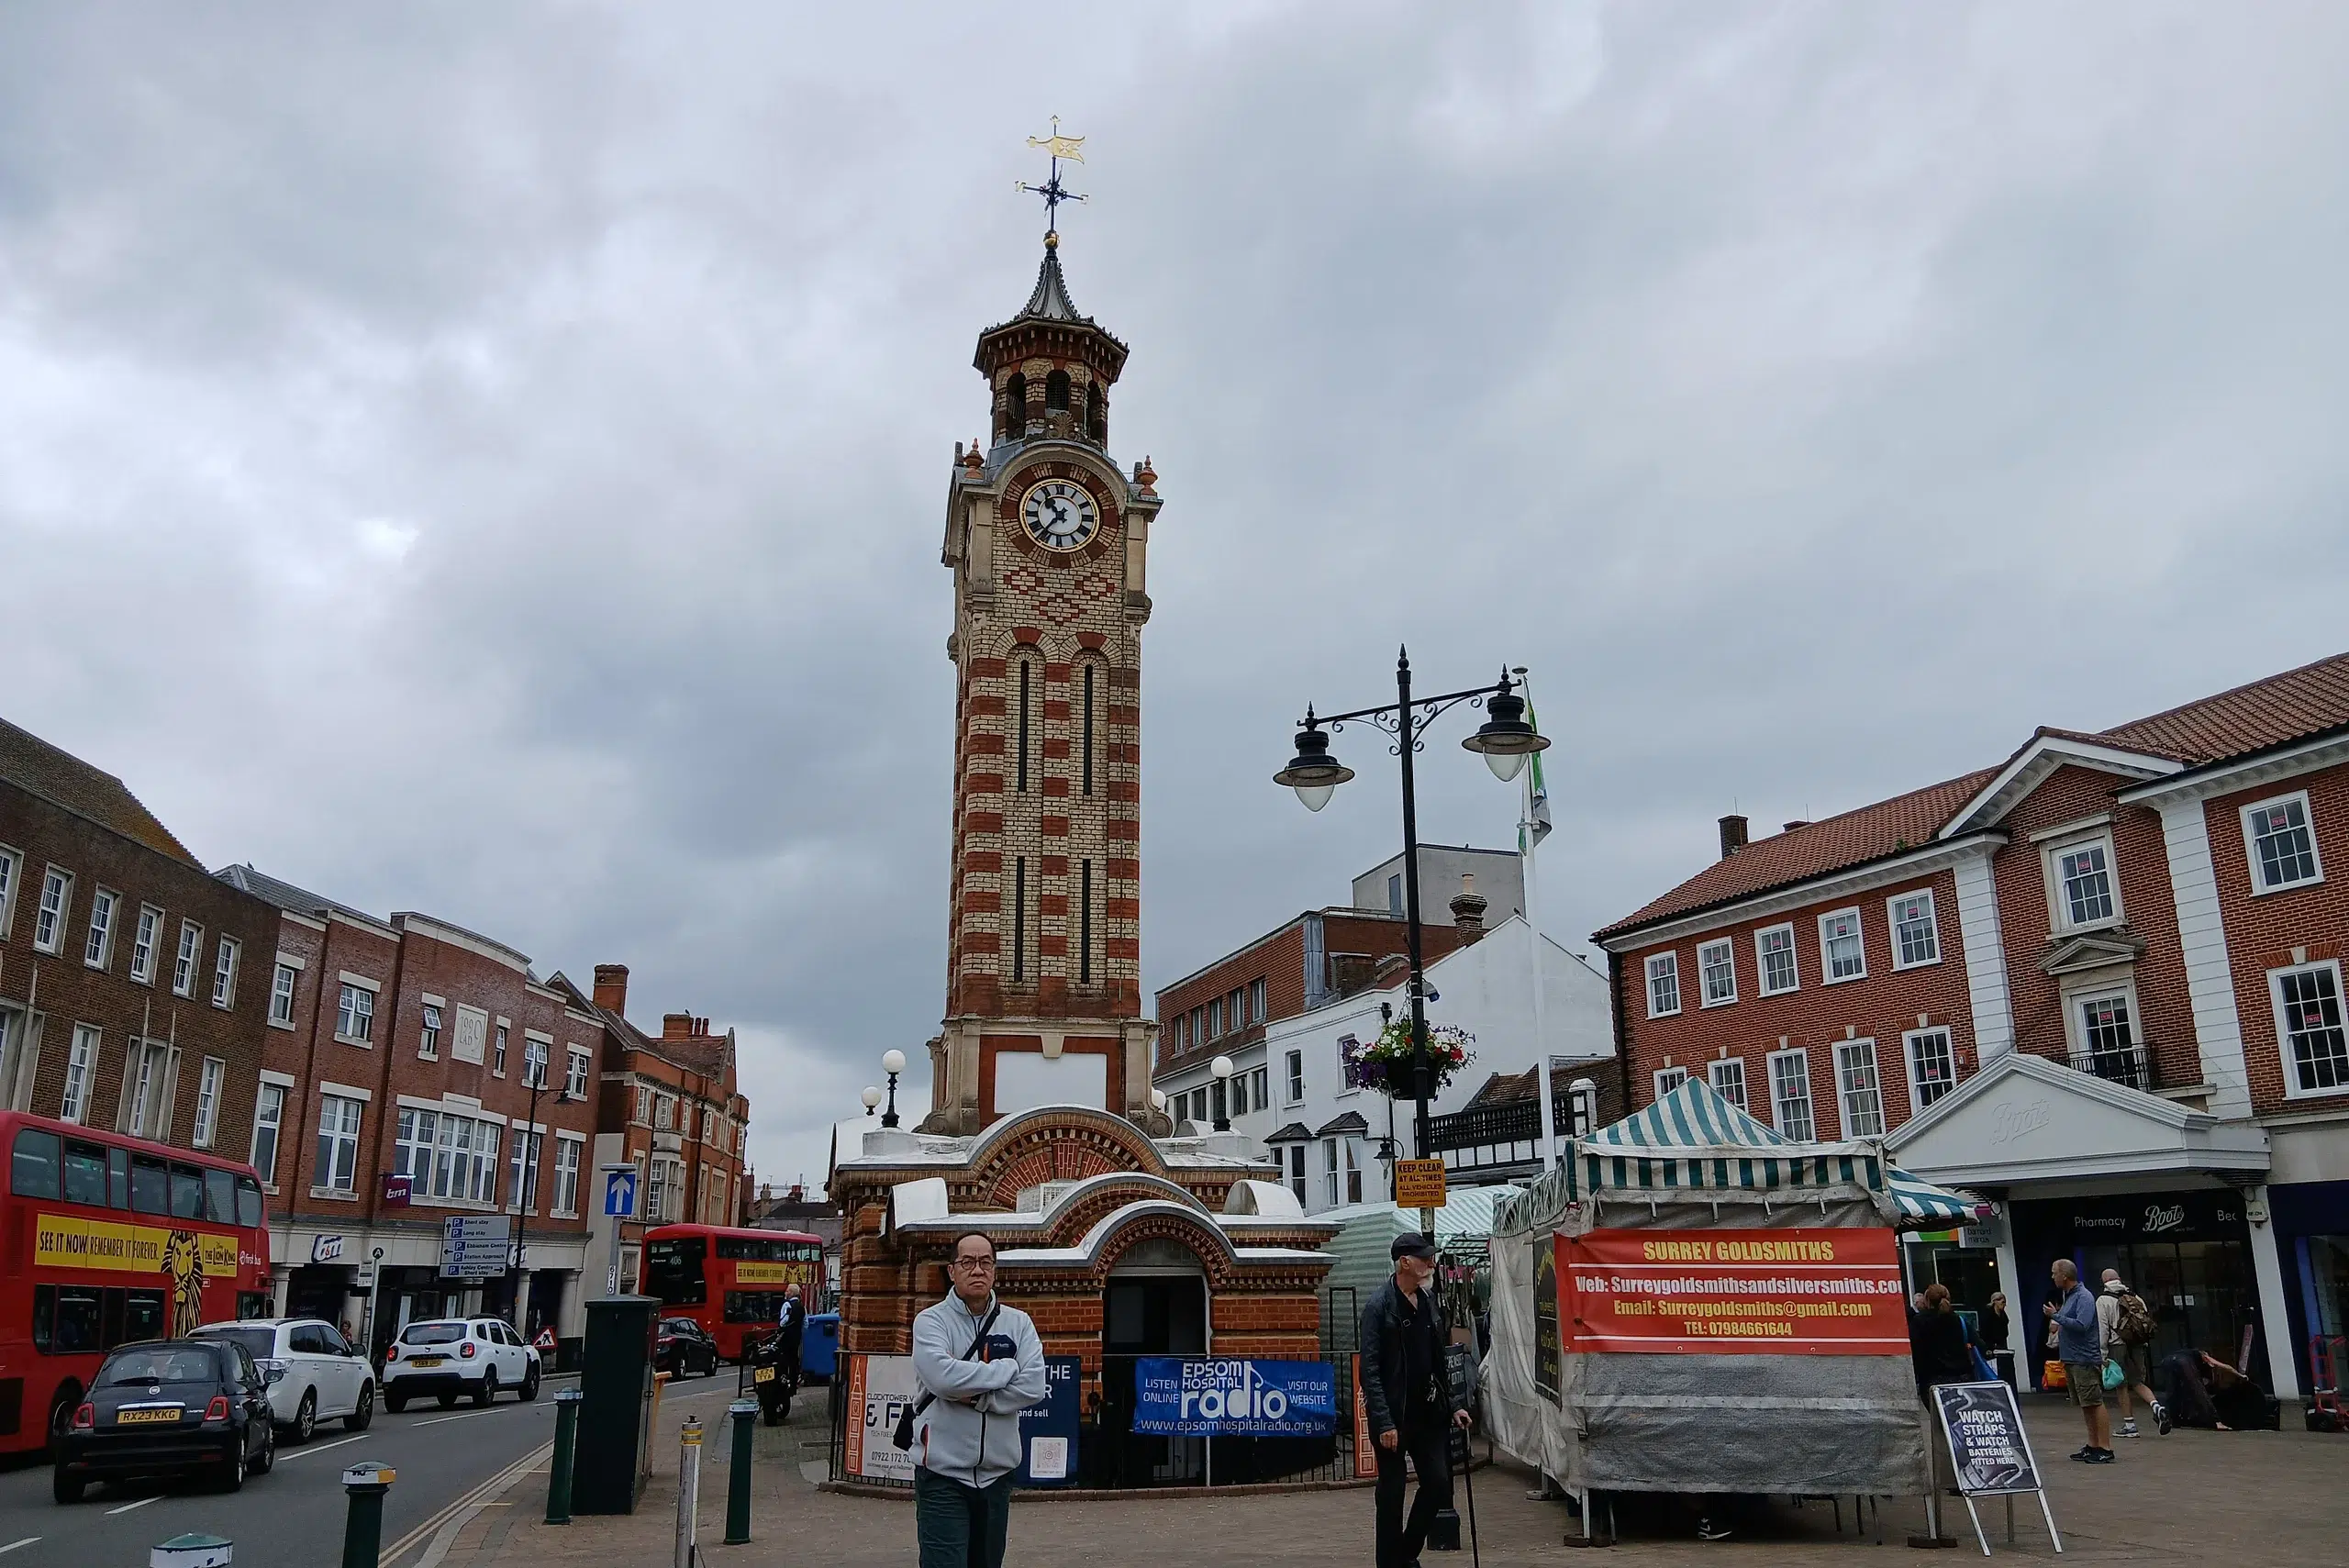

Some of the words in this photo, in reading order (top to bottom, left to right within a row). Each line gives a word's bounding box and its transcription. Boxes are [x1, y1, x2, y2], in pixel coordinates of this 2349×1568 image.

[1397, 1164, 1416, 1173] KEEP
[1419, 1163, 1442, 1173] CLEAR
[2074, 1217, 2126, 1229] Pharmacy
[2143, 1204, 2185, 1232] Boots
[39, 1230, 53, 1251] SEE
[56, 1233, 63, 1252] IT
[90, 1236, 124, 1258] REMEMBER
[126, 1240, 132, 1258] IT
[132, 1240, 159, 1260] FOREVER.
[1642, 1241, 1711, 1261] SURREY
[1716, 1241, 1834, 1261] GOLDSMITHS
[670, 1256, 682, 1265] 406
[1614, 1300, 1655, 1315] Email:
[1657, 1300, 1872, 1318] Surreygoldsmiths@gmail.com
[1684, 1321, 1708, 1335] TEL:
[1709, 1321, 1792, 1335] 07984661644
[1183, 1362, 1242, 1377] EPSOM
[1145, 1378, 1177, 1389] LISTEN
[1182, 1377, 1242, 1389] HOSPITAL
[1287, 1381, 1308, 1391] VISIT
[1309, 1381, 1328, 1392] OUR
[1180, 1362, 1286, 1418] radio
[867, 1393, 908, 1402] CLOCKTOWER
[1143, 1392, 1179, 1404] ONLINE
[1289, 1394, 1327, 1405] WEBSITE
[123, 1410, 151, 1421] RX23
[154, 1409, 176, 1419] KKG
[1958, 1410, 2004, 1423] WATCH
[1141, 1418, 1326, 1434] www.epsomhospitalradio.org.uk
[1963, 1424, 2007, 1436] STRAPS
[1965, 1437, 1974, 1446] &
[1976, 1437, 2009, 1446] WATCH
[872, 1451, 889, 1462] 07922
[891, 1452, 901, 1462] 172
[1968, 1448, 2012, 1457] BATTERIES
